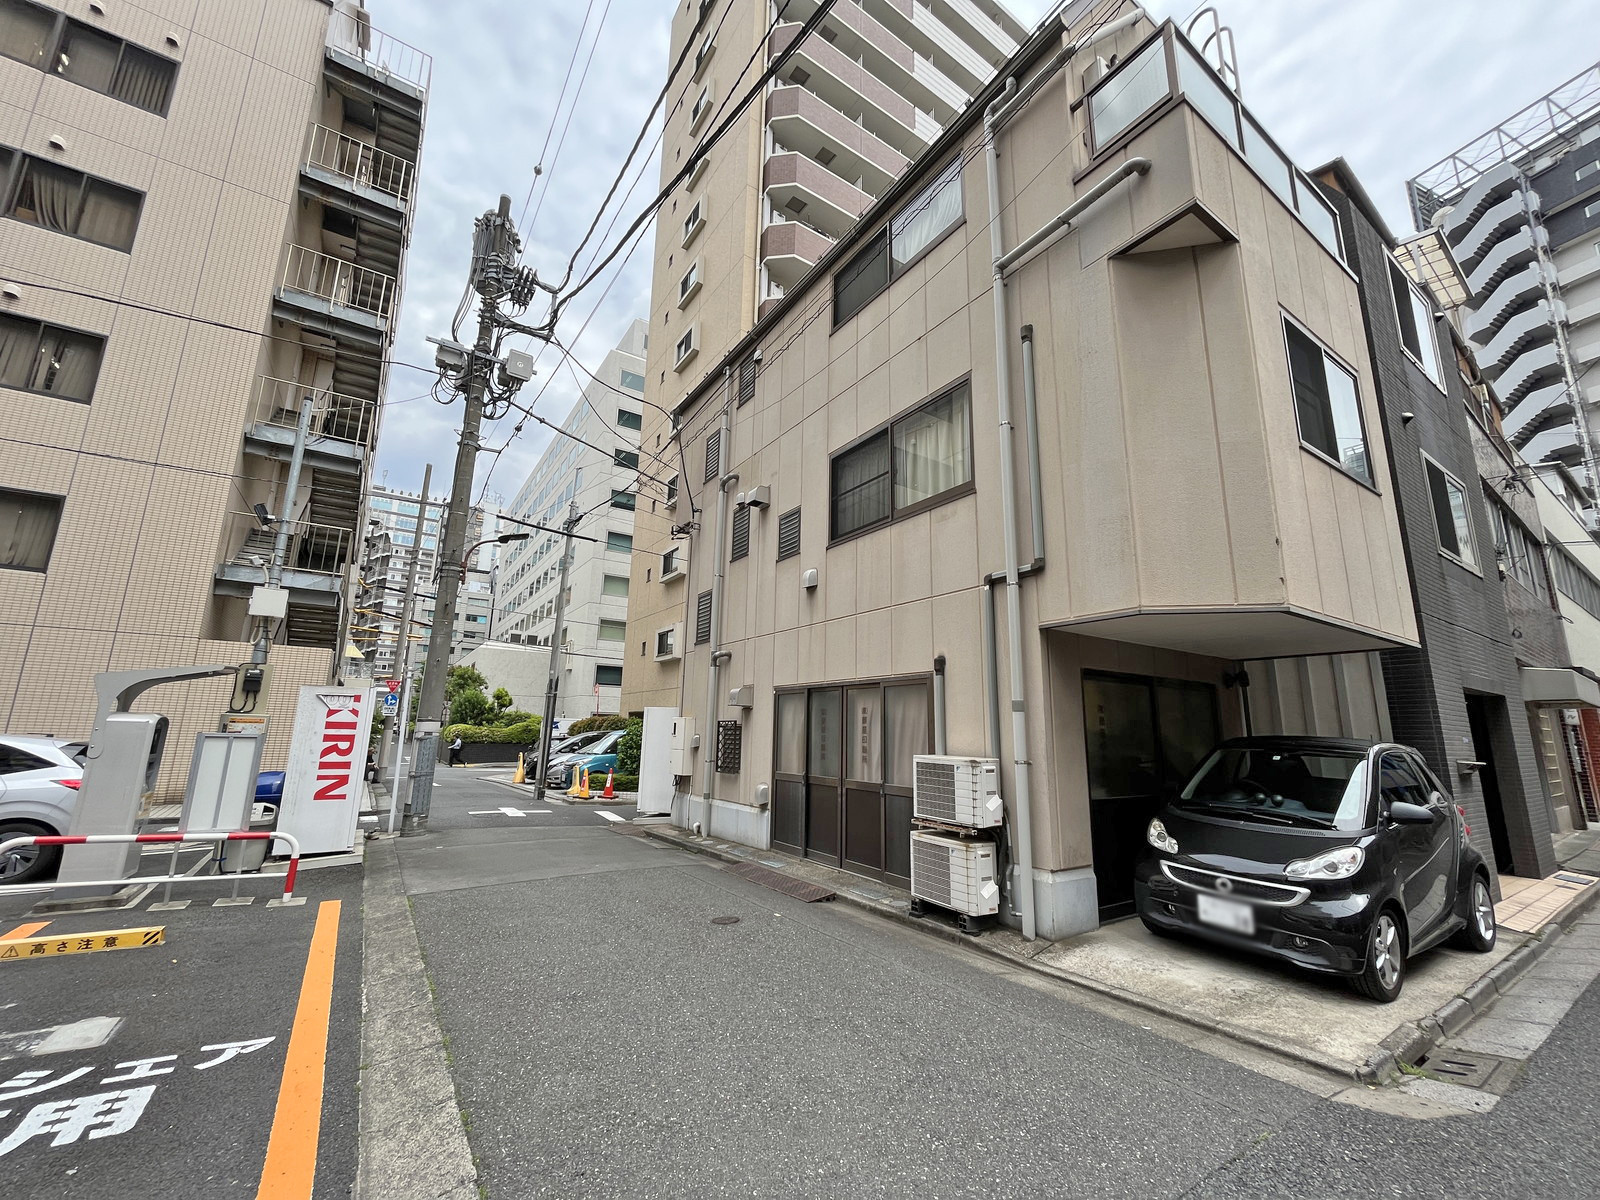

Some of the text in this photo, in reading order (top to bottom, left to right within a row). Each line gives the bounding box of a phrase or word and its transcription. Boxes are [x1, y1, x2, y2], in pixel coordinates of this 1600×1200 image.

[30, 936, 119, 955] 高さ注意
[0, 1085, 156, 1157] 用
